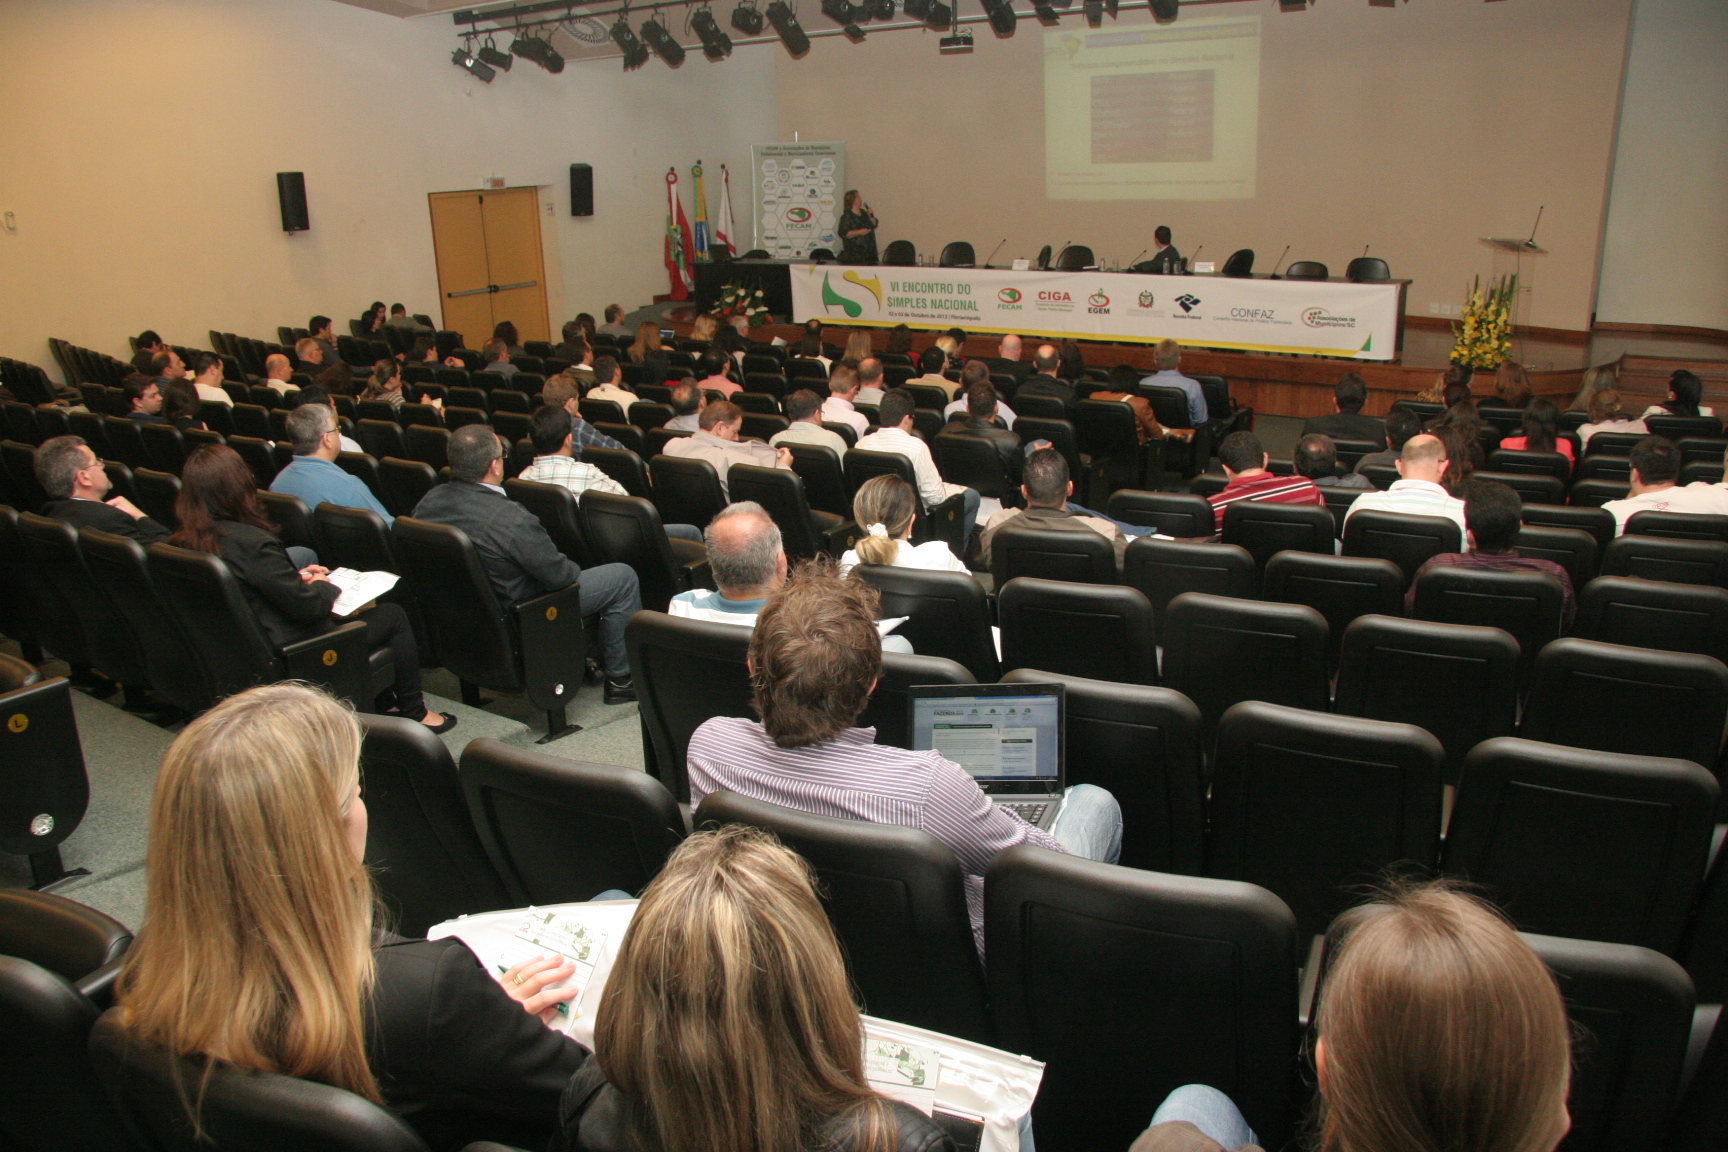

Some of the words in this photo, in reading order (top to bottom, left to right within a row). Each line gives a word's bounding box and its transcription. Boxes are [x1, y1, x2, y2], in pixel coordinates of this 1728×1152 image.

[890, 281, 899, 292] VI
[902, 282, 954, 294] ENCONTRO
[957, 283, 972, 295] DO
[1038, 291, 1072, 301] CIGA
[887, 296, 928, 309] SIMPLES
[930, 298, 980, 312] NACIONAL
[1230, 308, 1274, 319] CONFAZ
